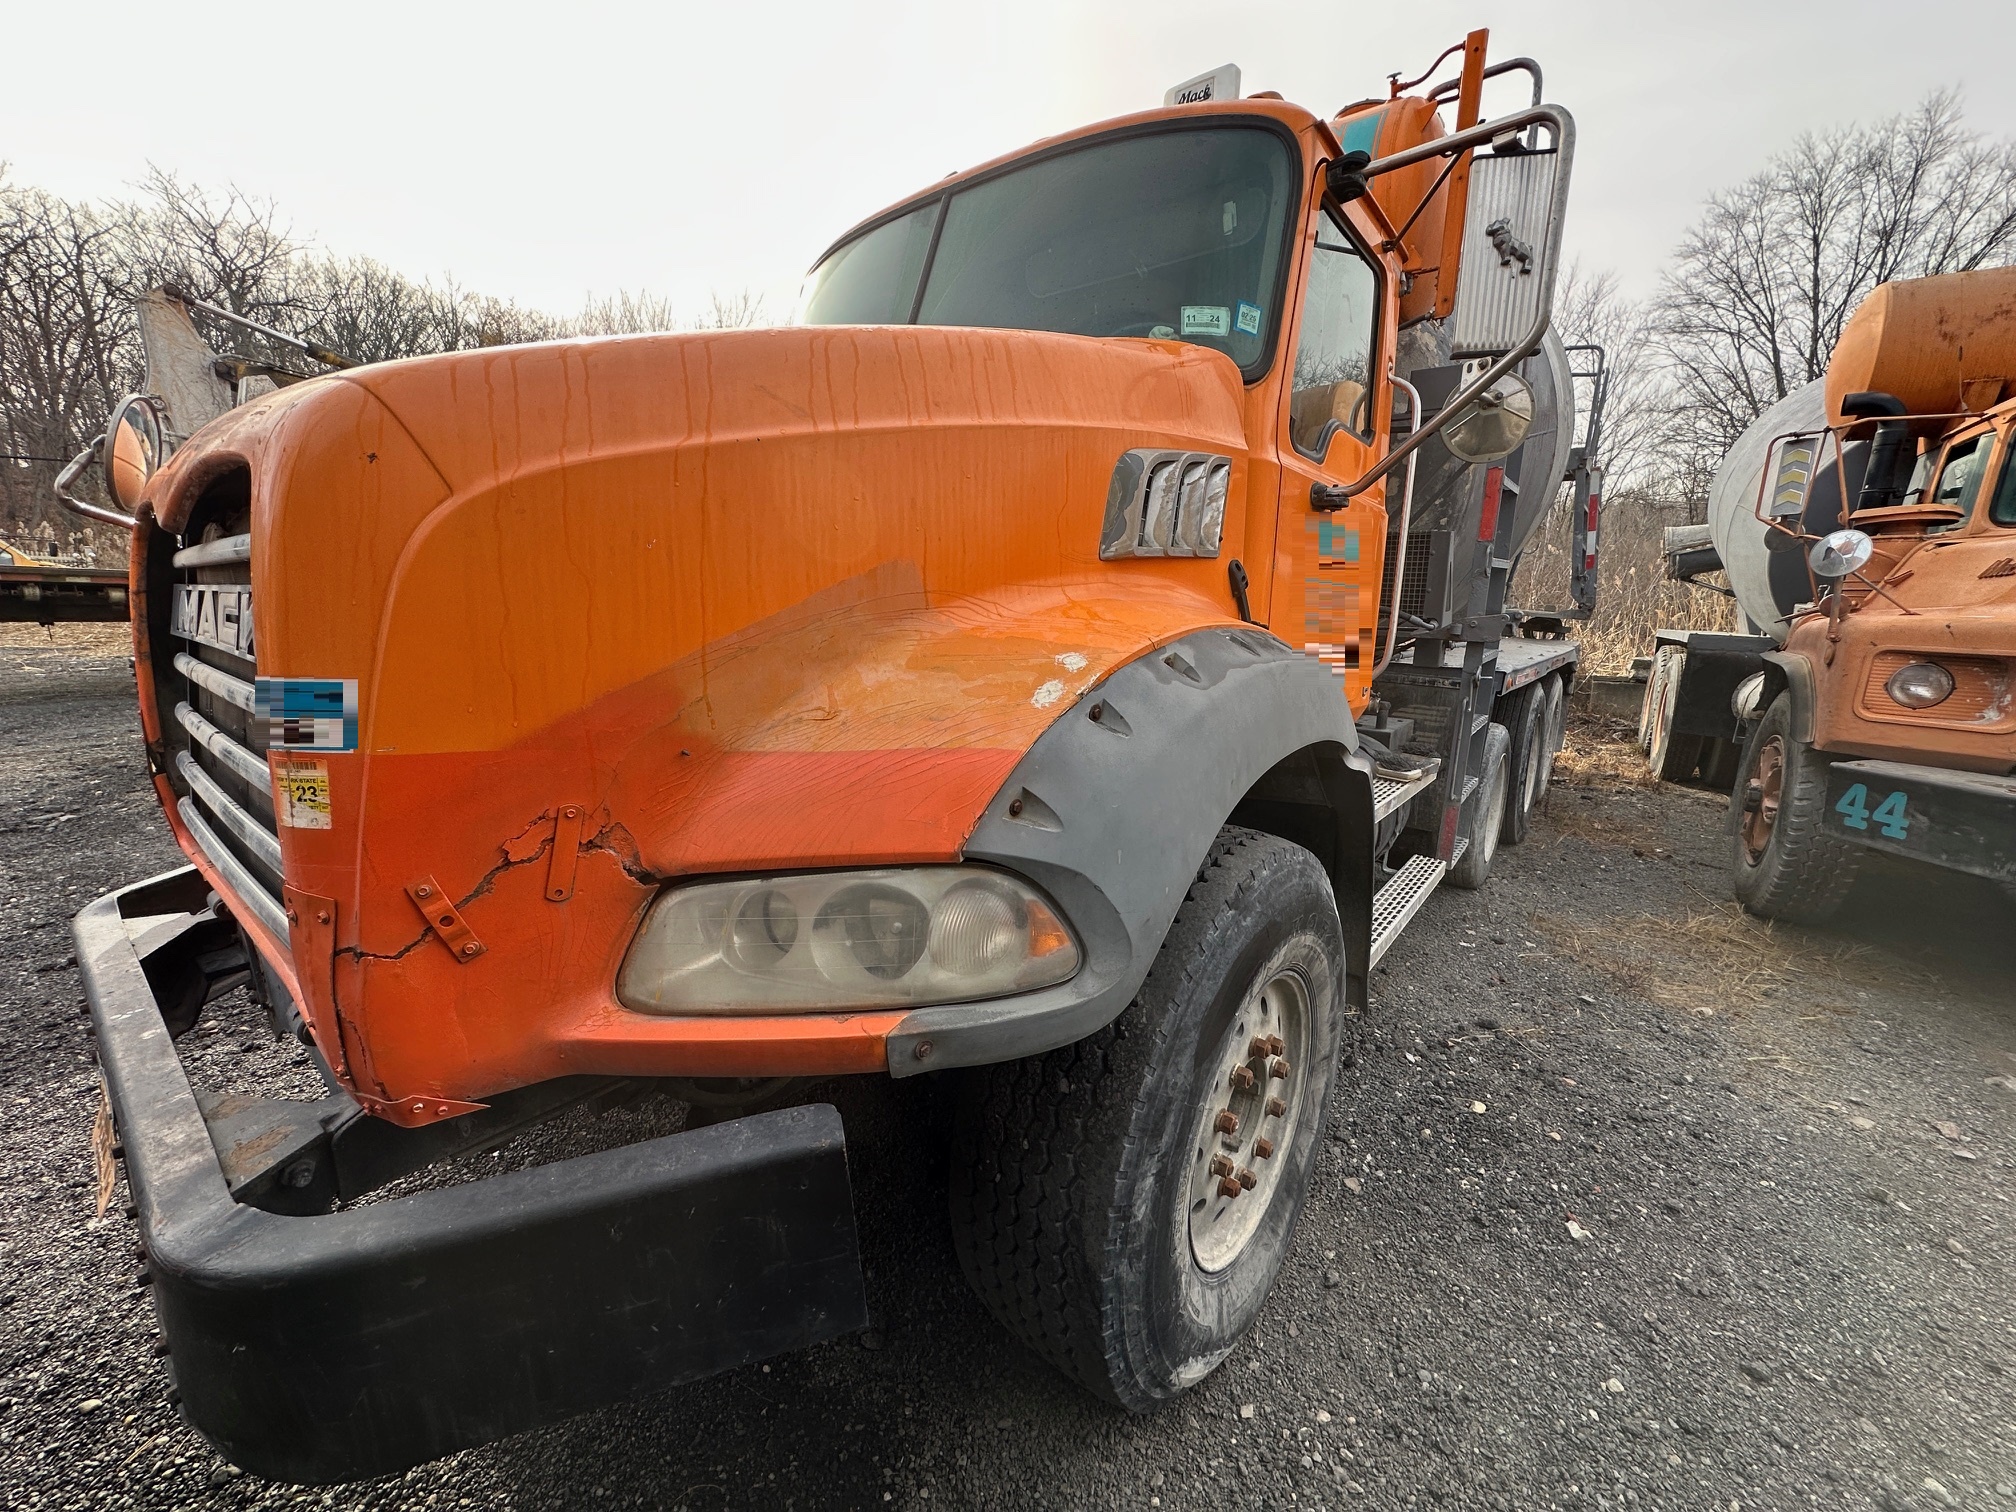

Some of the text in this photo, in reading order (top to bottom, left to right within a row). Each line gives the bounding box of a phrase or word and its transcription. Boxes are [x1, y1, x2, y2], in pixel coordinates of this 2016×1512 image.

[1178, 84, 1212, 104] Mack
[1186, 314, 1197, 322] 11
[296, 785, 318, 802] 23
[1835, 783, 1910, 839] 44
